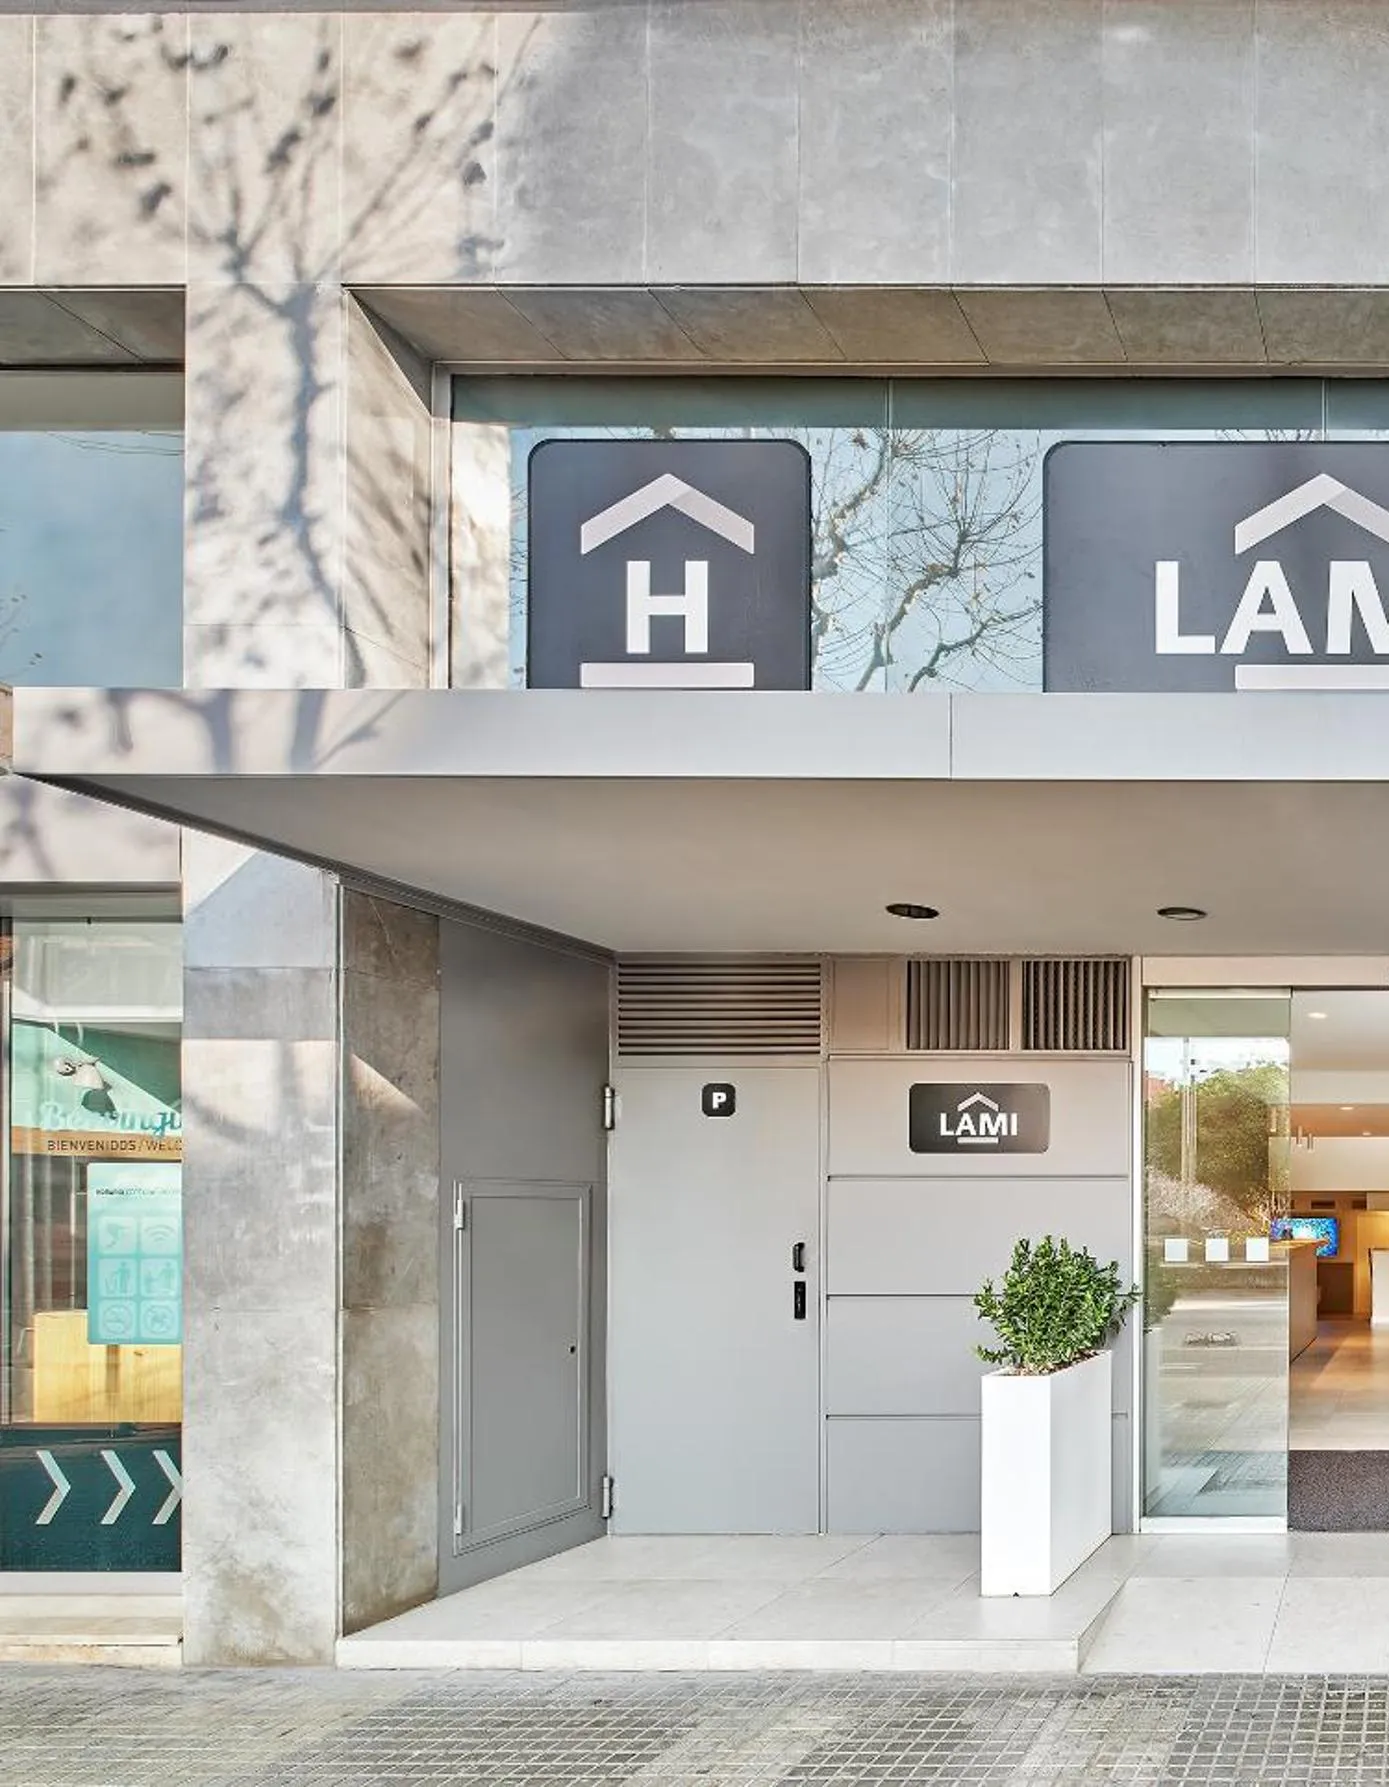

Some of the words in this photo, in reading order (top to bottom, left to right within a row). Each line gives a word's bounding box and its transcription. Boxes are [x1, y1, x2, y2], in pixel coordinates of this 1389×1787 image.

[626, 560, 709, 654] H
[712, 1091, 727, 1109] P
[939, 1112, 1018, 1136] LAMI
